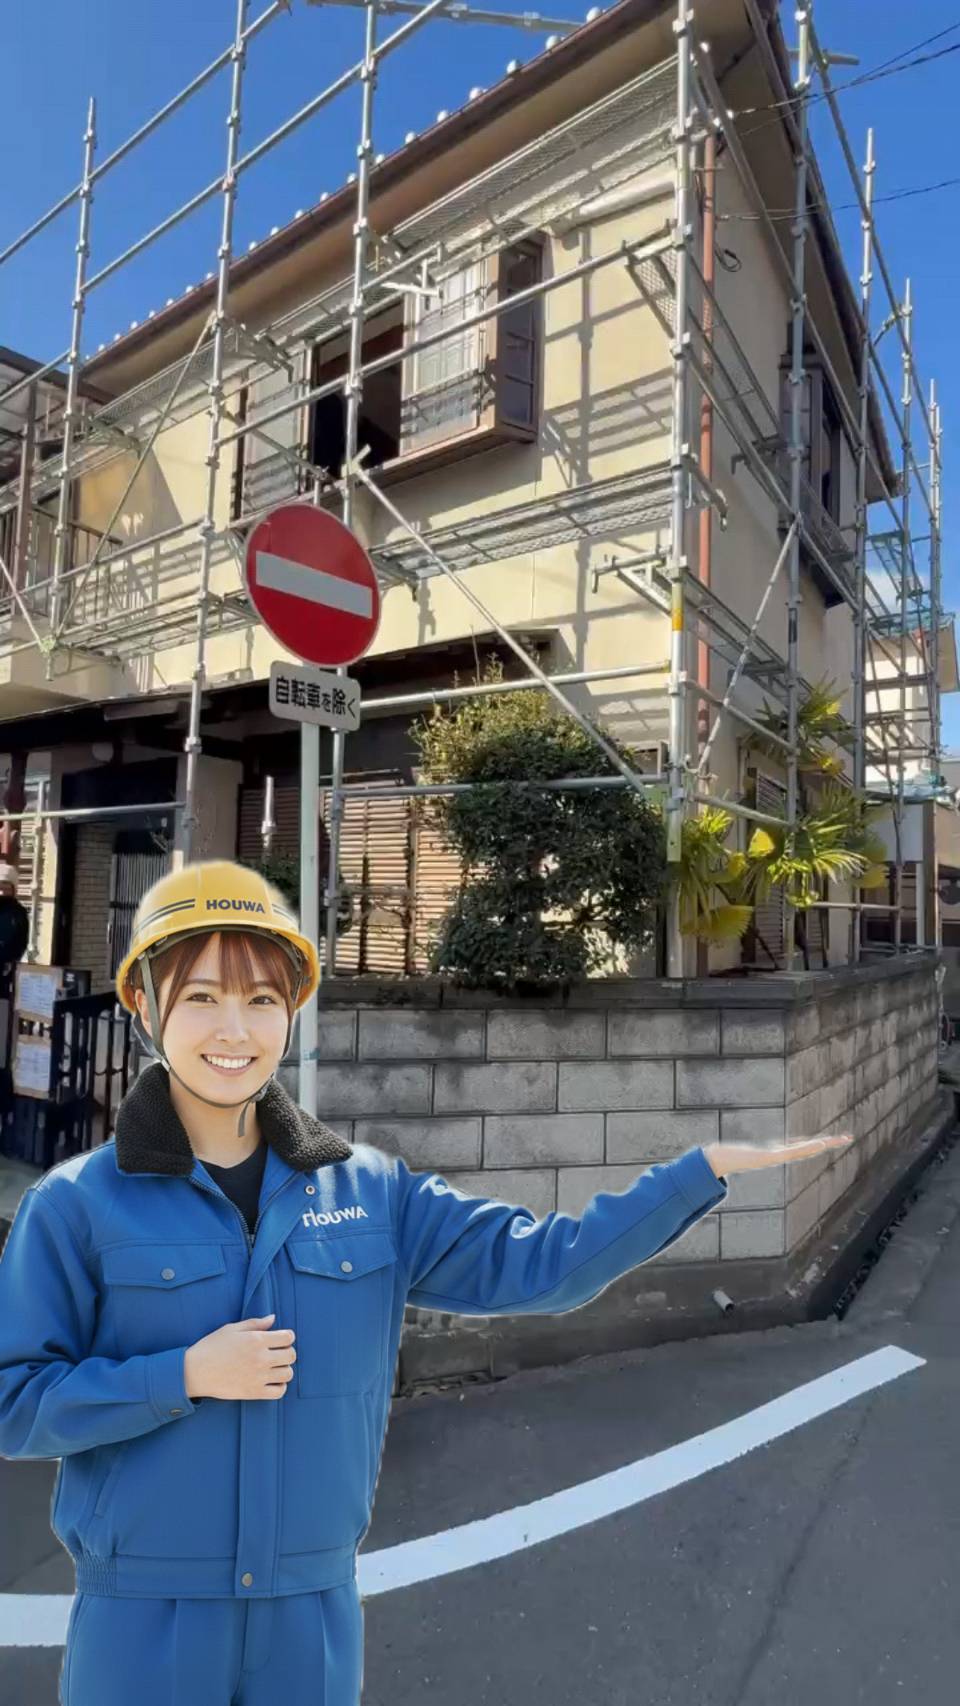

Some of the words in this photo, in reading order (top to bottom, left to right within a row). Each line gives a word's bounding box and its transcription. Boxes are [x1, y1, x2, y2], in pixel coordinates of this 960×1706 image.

[276, 675, 356, 718] 自転車を除く
[206, 898, 265, 913] HOUWA
